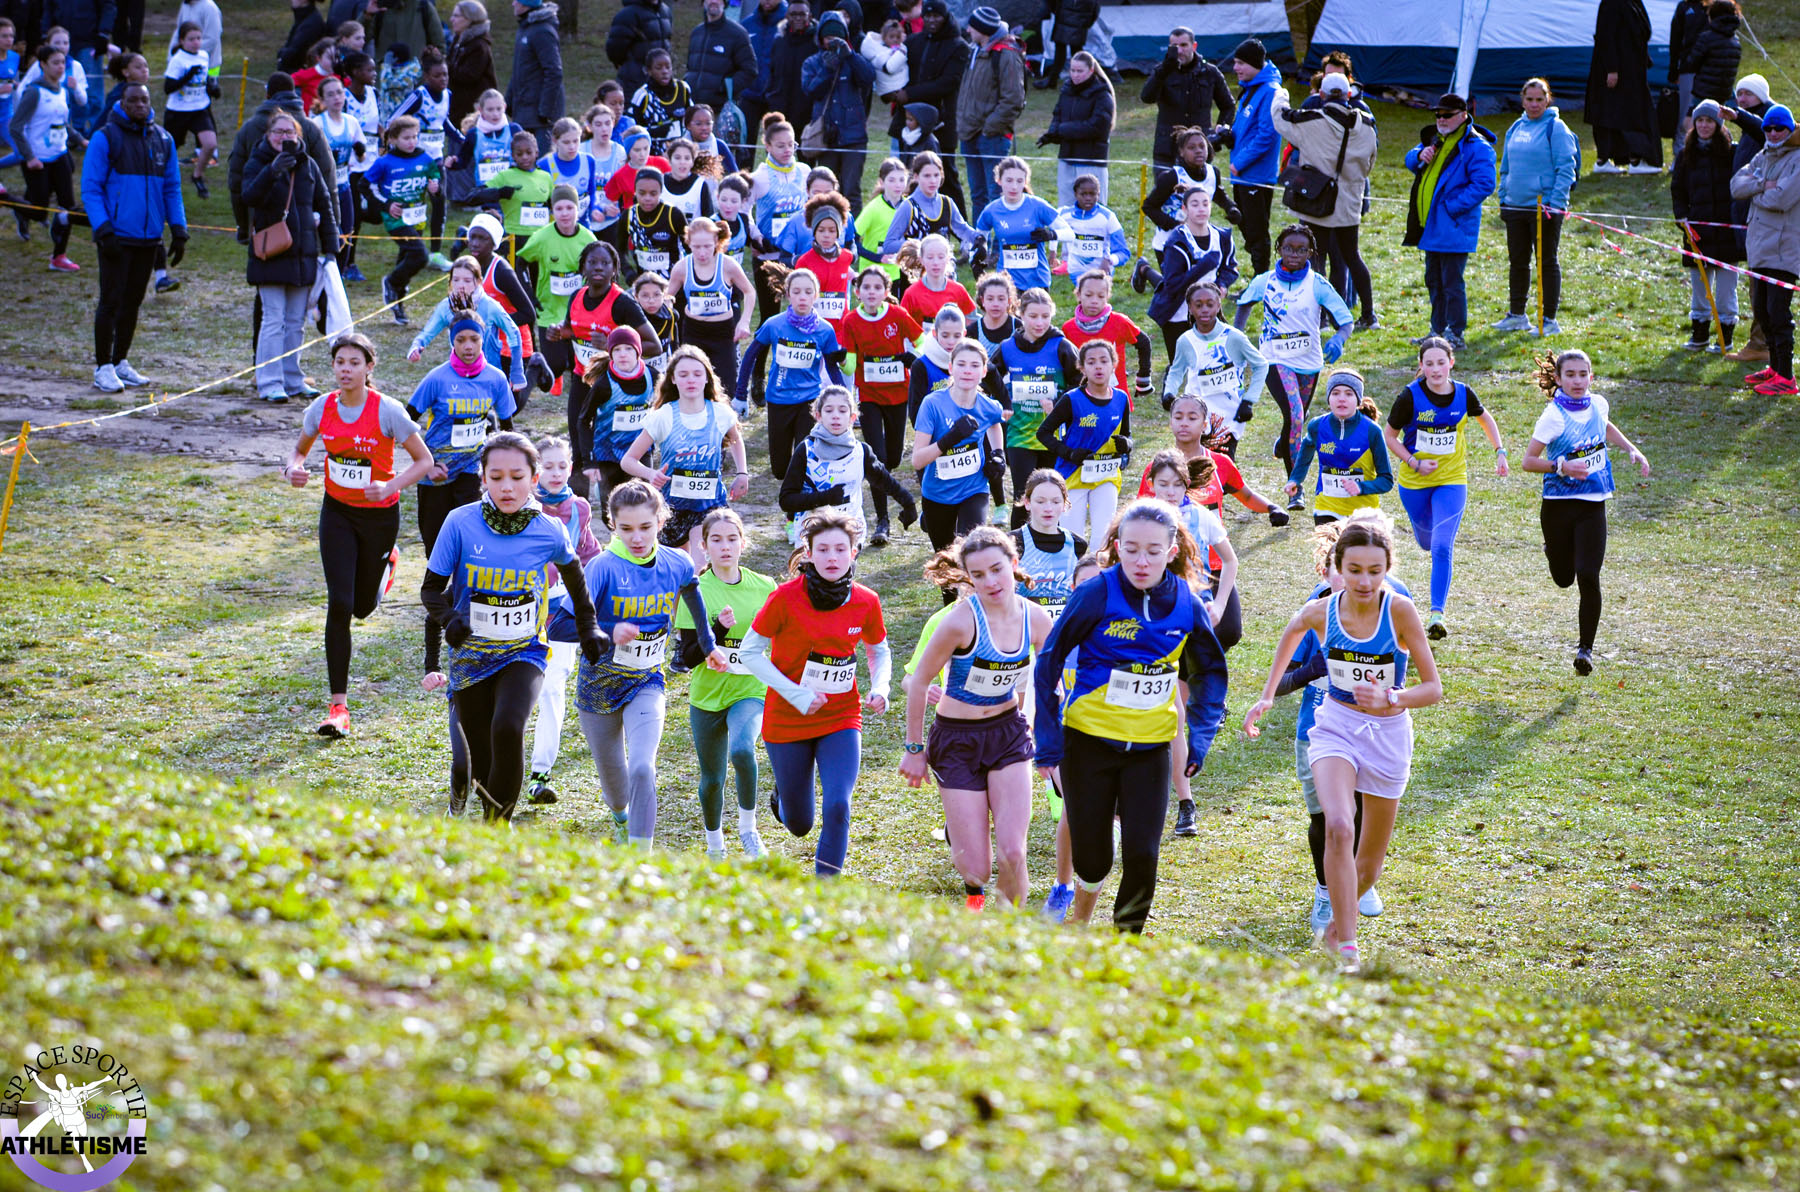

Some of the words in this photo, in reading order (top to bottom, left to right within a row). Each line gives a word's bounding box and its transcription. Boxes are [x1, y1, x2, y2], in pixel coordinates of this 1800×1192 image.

[1082, 242, 1098, 251] 553
[647, 254, 664, 263] 480
[1014, 252, 1035, 261] 1457
[704, 300, 722, 308] 960
[820, 301, 843, 310] 1194
[1284, 339, 1310, 350] 1275
[787, 350, 813, 361] 1460
[879, 364, 898, 374] 644
[1209, 371, 1235, 387] 1272
[1028, 385, 1049, 394] 588
[1429, 435, 1455, 446] 1332
[950, 453, 977, 469] 1461
[341, 468, 363, 480] 761
[688, 480, 711, 491] 952
[491, 608, 531, 626] 1131
[635, 639, 664, 657] 1127
[1355, 653, 1375, 663] i-run
[1144, 664, 1163, 674] i-run
[822, 668, 854, 682] 1195
[992, 672, 1021, 686] 957
[1132, 679, 1172, 695] 1331
